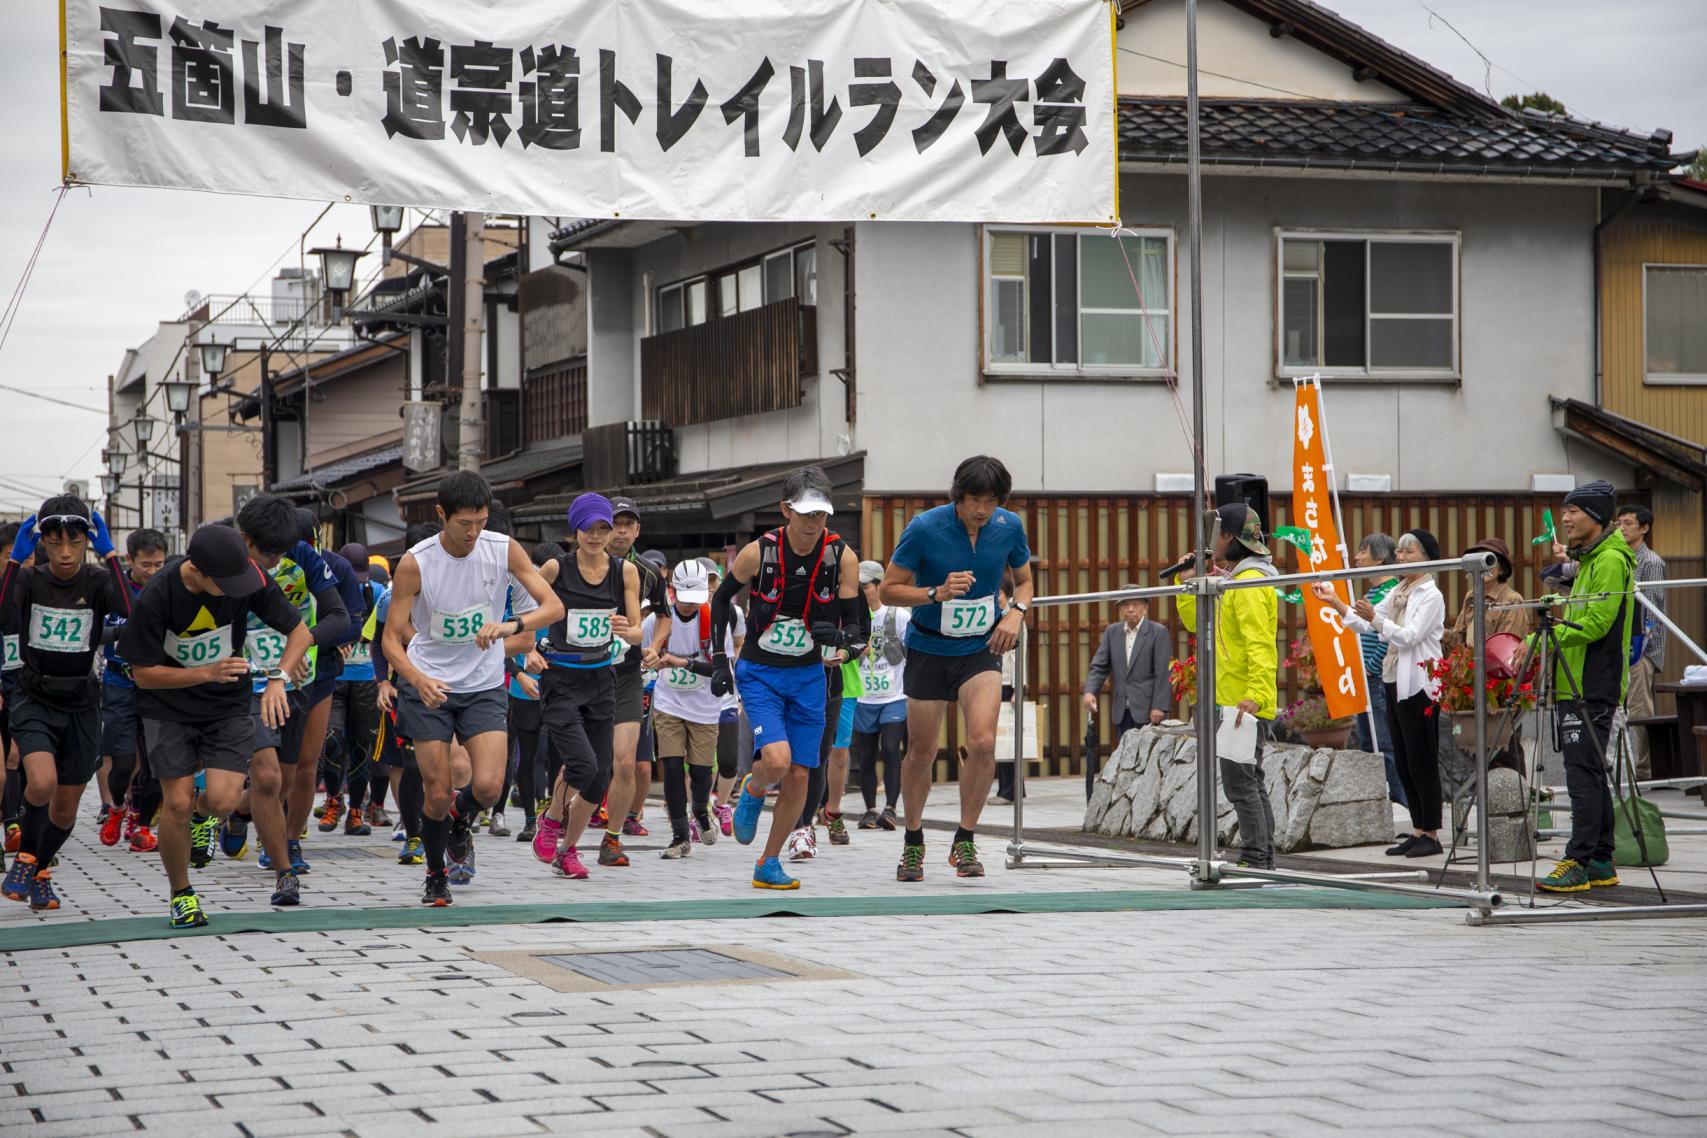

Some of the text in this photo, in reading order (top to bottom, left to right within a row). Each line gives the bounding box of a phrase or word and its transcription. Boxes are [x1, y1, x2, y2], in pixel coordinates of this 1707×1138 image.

[39, 614, 82, 642] 542
[443, 612, 485, 639] 538
[577, 616, 611, 639] 585
[952, 605, 987, 629] 572
[256, 634, 285, 661] 53
[769, 622, 807, 648] 552
[176, 635, 222, 662] 505
[865, 675, 890, 691] 536
